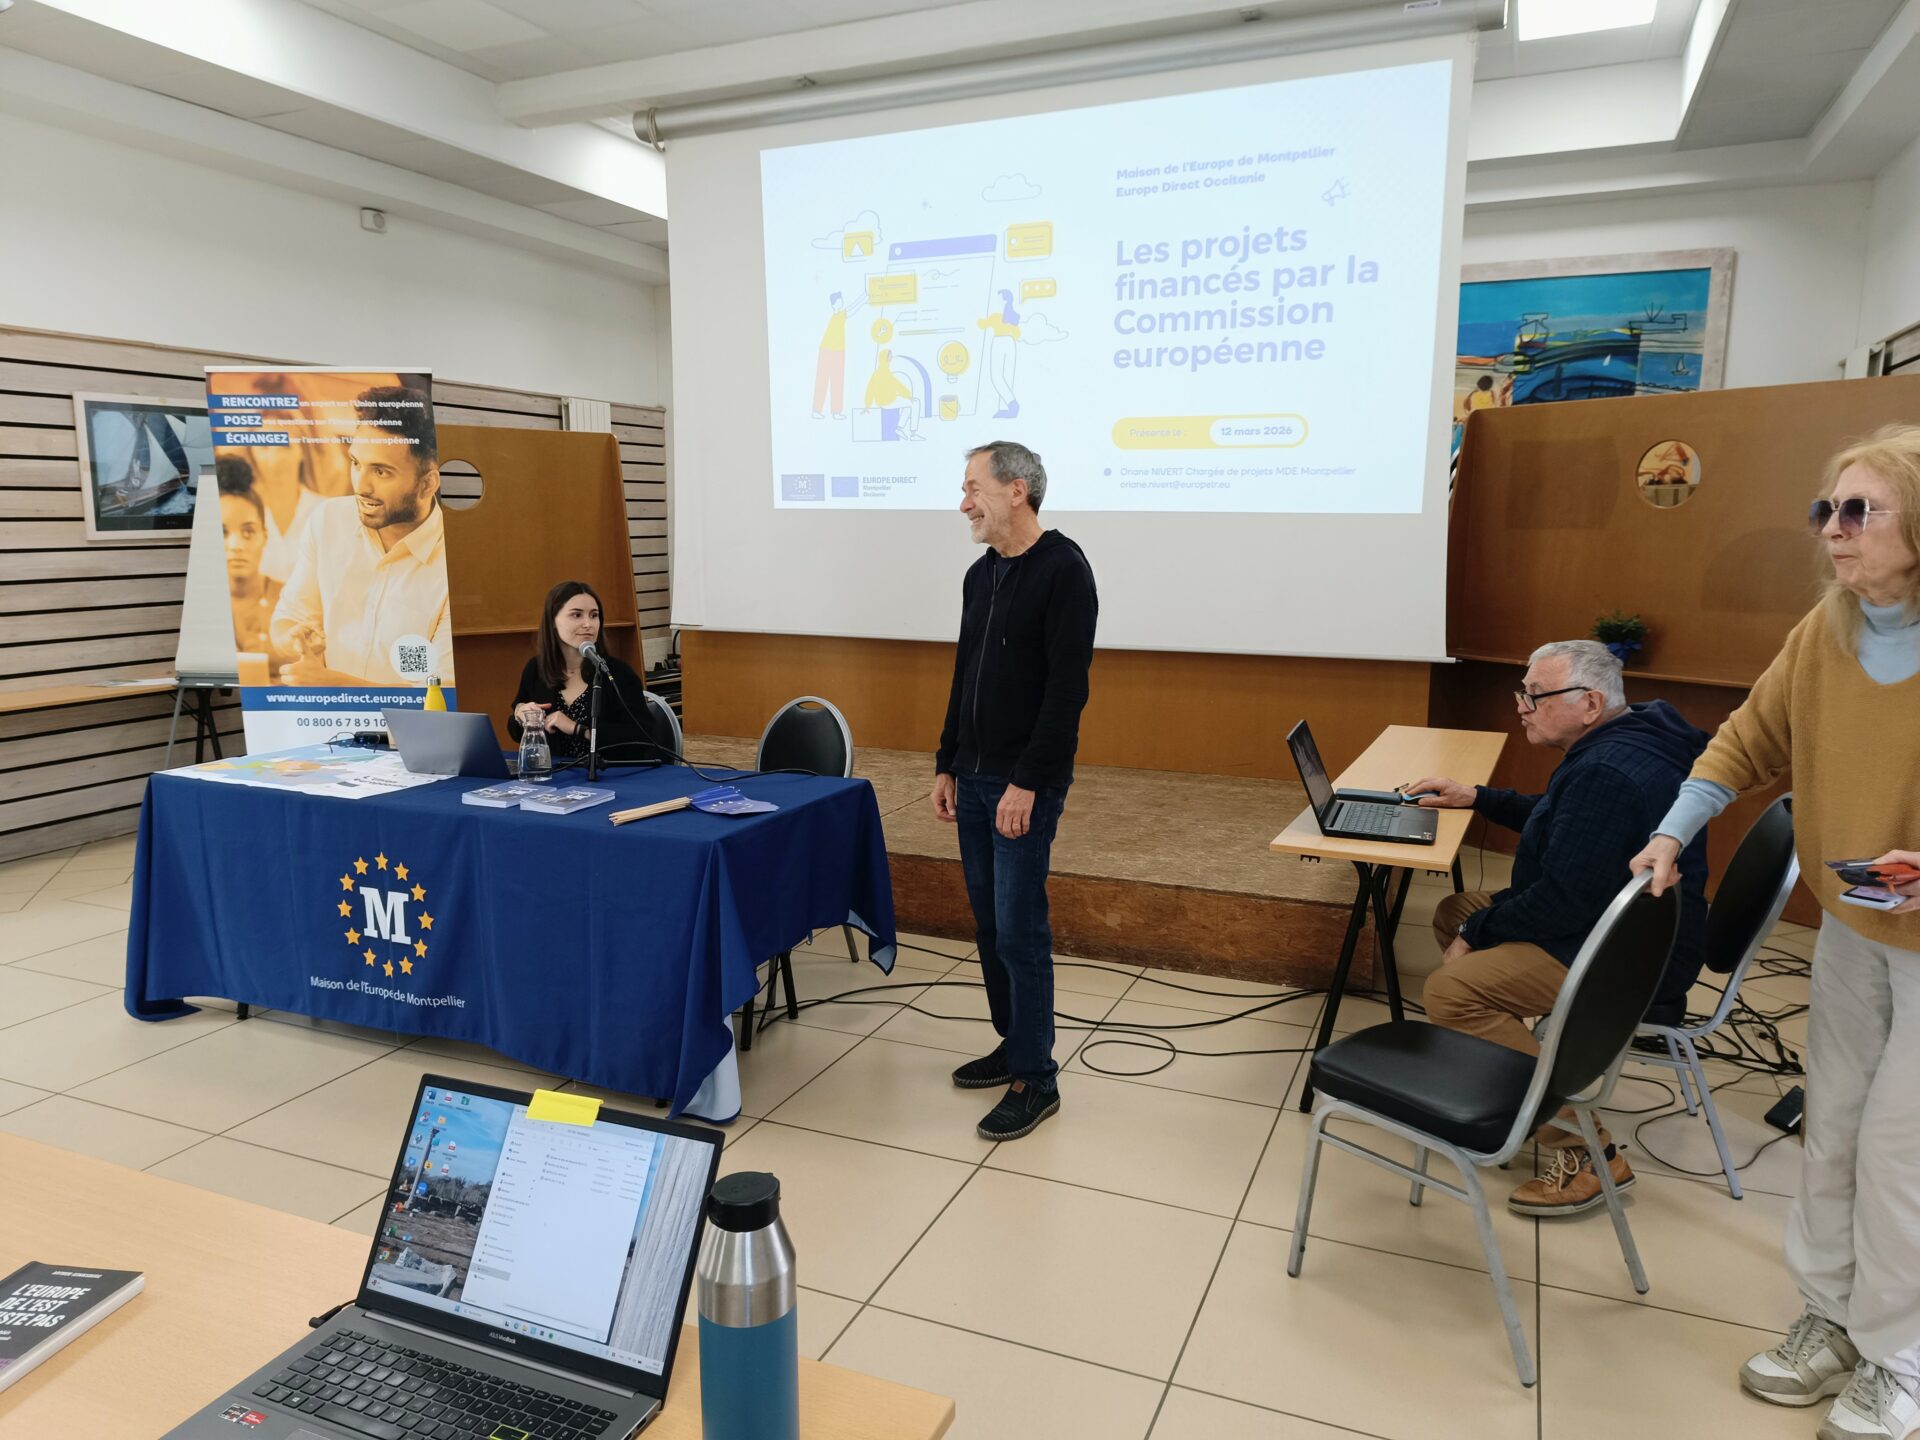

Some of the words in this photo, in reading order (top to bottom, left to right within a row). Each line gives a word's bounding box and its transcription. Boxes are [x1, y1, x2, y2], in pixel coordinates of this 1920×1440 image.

[1116, 165, 1160, 179] Maison
[1164, 163, 1179, 175] de
[1182, 158, 1234, 173] l'Europe
[1238, 155, 1254, 166] de
[1257, 146, 1337, 164] Montpellier
[1116, 185, 1159, 198] Europe
[1162, 179, 1200, 192] Direct
[1203, 171, 1266, 188] Occitanie
[1116, 240, 1170, 266] Les
[1181, 225, 1308, 268] projets
[1114, 264, 1261, 301] financés
[1273, 264, 1335, 297] par
[1346, 254, 1379, 284] la
[1113, 296, 1334, 335] Commission
[1113, 337, 1326, 372] européenne
[222, 397, 298, 407] RENCONTREZ
[378, 400, 424, 409] européenne
[224, 415, 262, 425] POSEZ
[225, 432, 289, 443] ÉCHANGEZ
[371, 437, 420, 445] européenne
[1220, 427, 1233, 436] 12
[1234, 428, 1261, 436] mars
[1263, 426, 1293, 436] 2026
[862, 476, 891, 484] EUROPE
[891, 476, 918, 484] DIRECT
[1120, 467, 1149, 477] Oriane
[1151, 467, 1184, 476] NIVERT
[1185, 466, 1225, 479] Chargée
[1226, 467, 1239, 476] de
[1240, 467, 1273, 480] projets
[1275, 466, 1298, 476] MDE
[1300, 466, 1357, 478] Montpellier
[297, 717, 310, 727] 00
[312, 718, 333, 727] 800
[335, 718, 342, 727] 6
[345, 718, 352, 727] 7
[354, 718, 361, 727] 8
[364, 718, 370, 727] 9
[373, 718, 387, 727] 10
[359, 886, 411, 945] M
[310, 976, 344, 990] Maison
[346, 979, 360, 991] de
[394, 989, 405, 1002] de
[406, 993, 466, 1008] Montpellier
[11, 1284, 92, 1299] L'EUROPE
[0, 1297, 28, 1310] DE
[16, 1298, 69, 1312] L'EST
[24, 1313, 66, 1327] PAS
